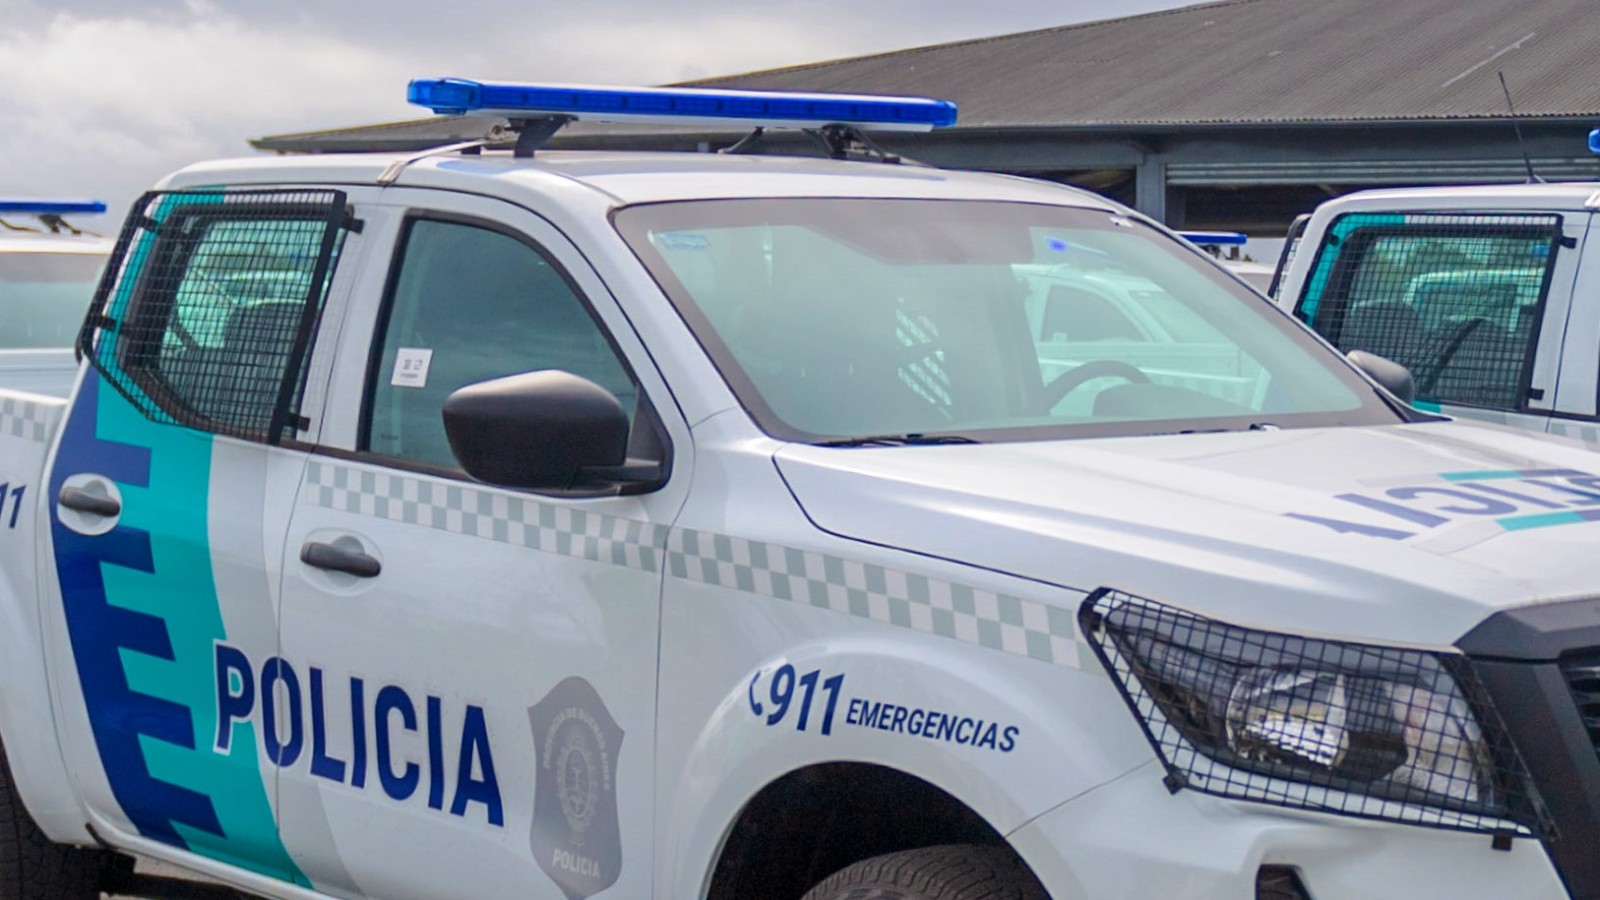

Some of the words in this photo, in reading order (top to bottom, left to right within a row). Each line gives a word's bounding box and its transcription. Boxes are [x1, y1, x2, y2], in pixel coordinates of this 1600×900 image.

[215, 643, 504, 828] POLICIA
[766, 663, 845, 736] 911
[846, 698, 1020, 752] EMERGENCIAS
[552, 849, 600, 877] POLICIA
